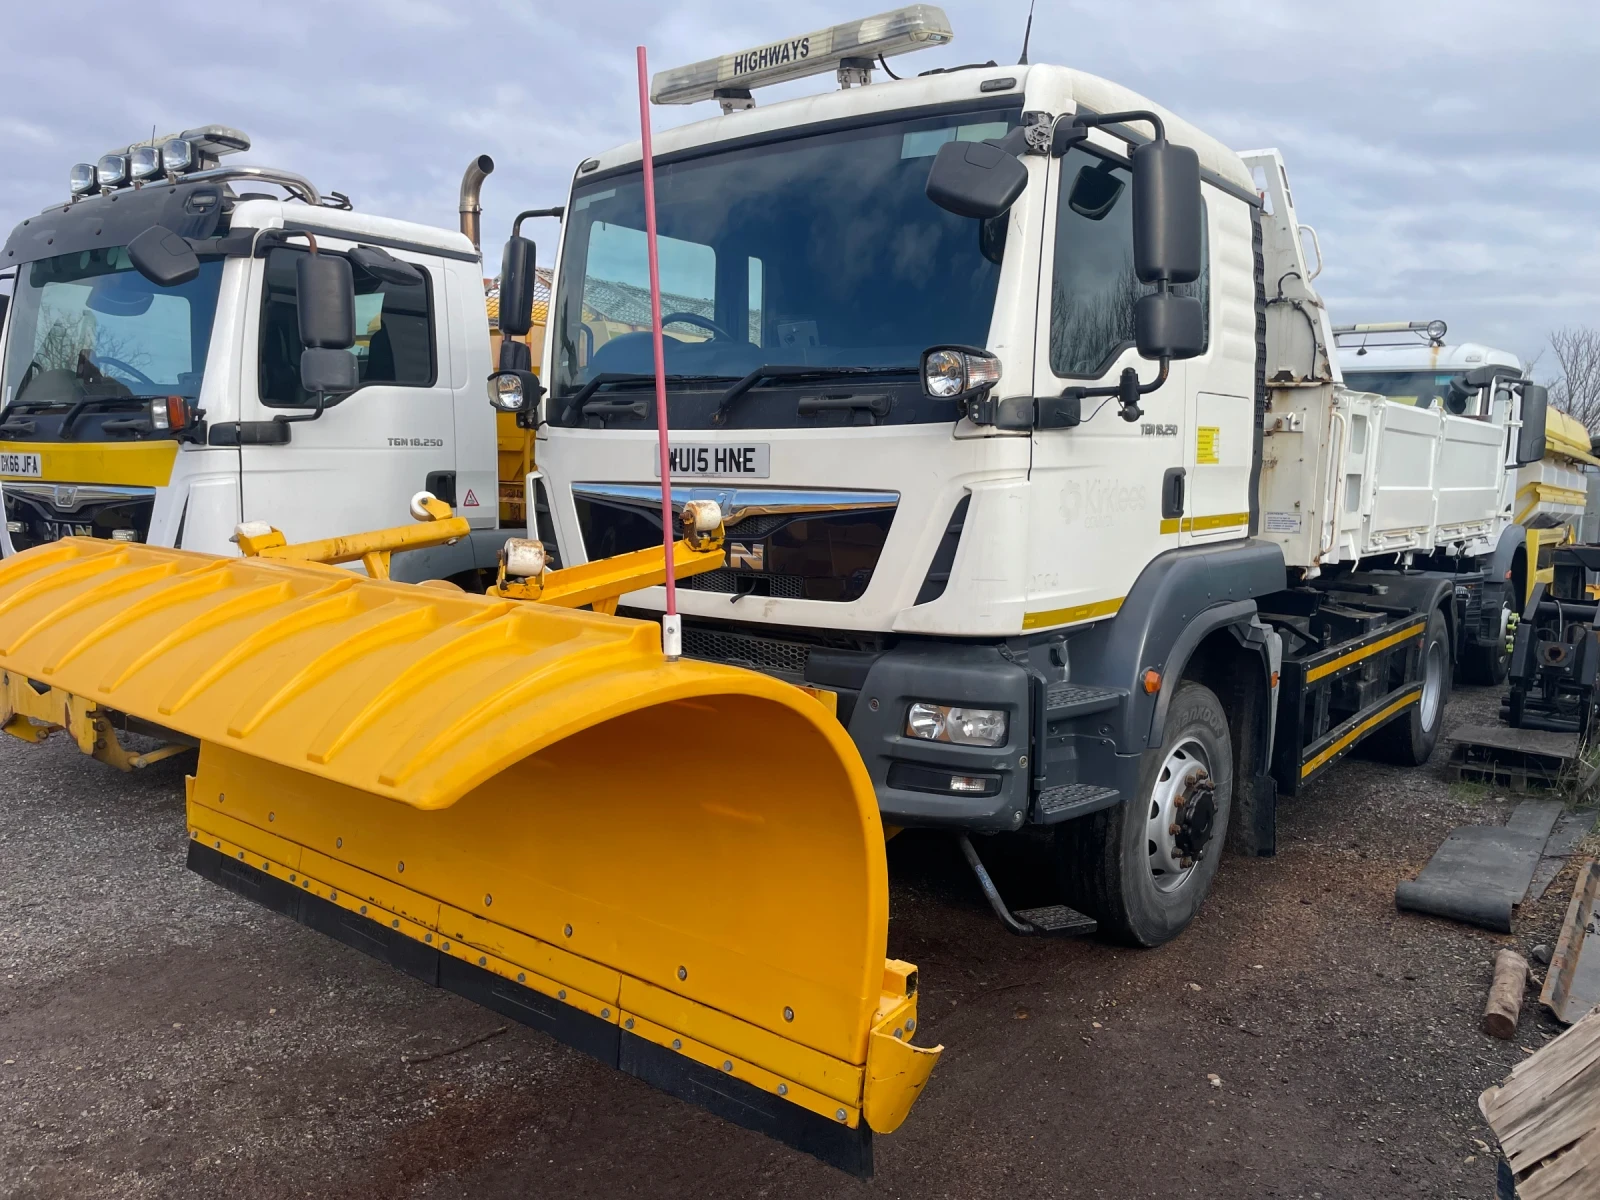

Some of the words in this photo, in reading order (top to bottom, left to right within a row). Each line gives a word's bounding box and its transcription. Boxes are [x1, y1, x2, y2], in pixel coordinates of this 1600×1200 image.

[734, 37, 809, 76] HIGHWAYS
[387, 437, 408, 446] TGM
[409, 438, 443, 447] 18.250
[1, 455, 19, 473] DK66
[21, 456, 38, 474] JFA
[668, 447, 708, 473] WU15
[715, 447, 756, 473] HNE
[43, 522, 93, 541] MAN
